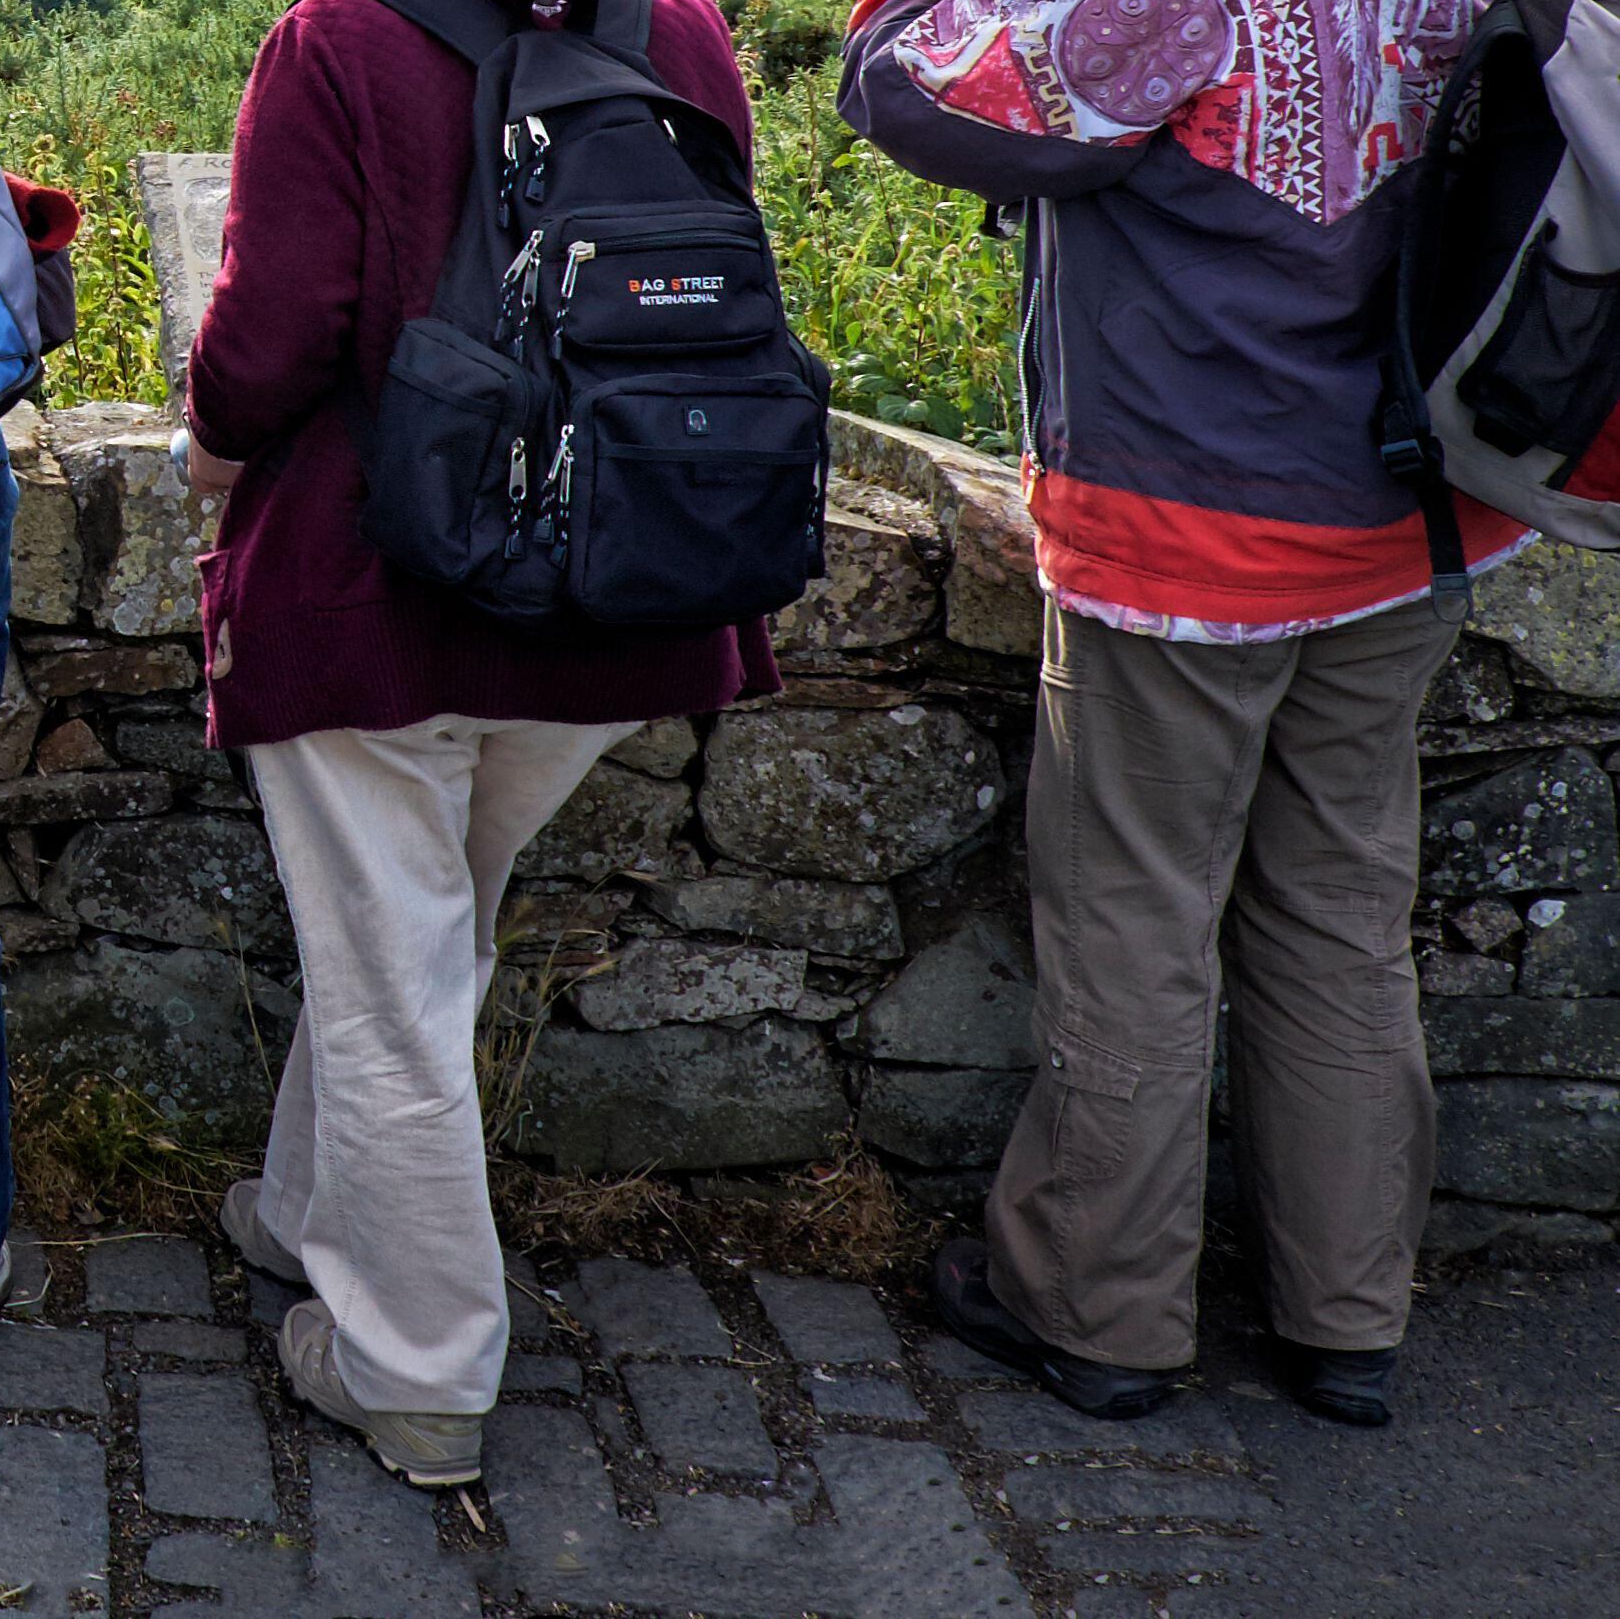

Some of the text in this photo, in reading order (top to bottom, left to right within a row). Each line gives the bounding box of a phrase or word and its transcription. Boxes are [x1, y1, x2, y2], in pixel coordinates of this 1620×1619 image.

[628, 276, 725, 293] BAG STREET
[639, 293, 720, 306] INTERNATIONAL
